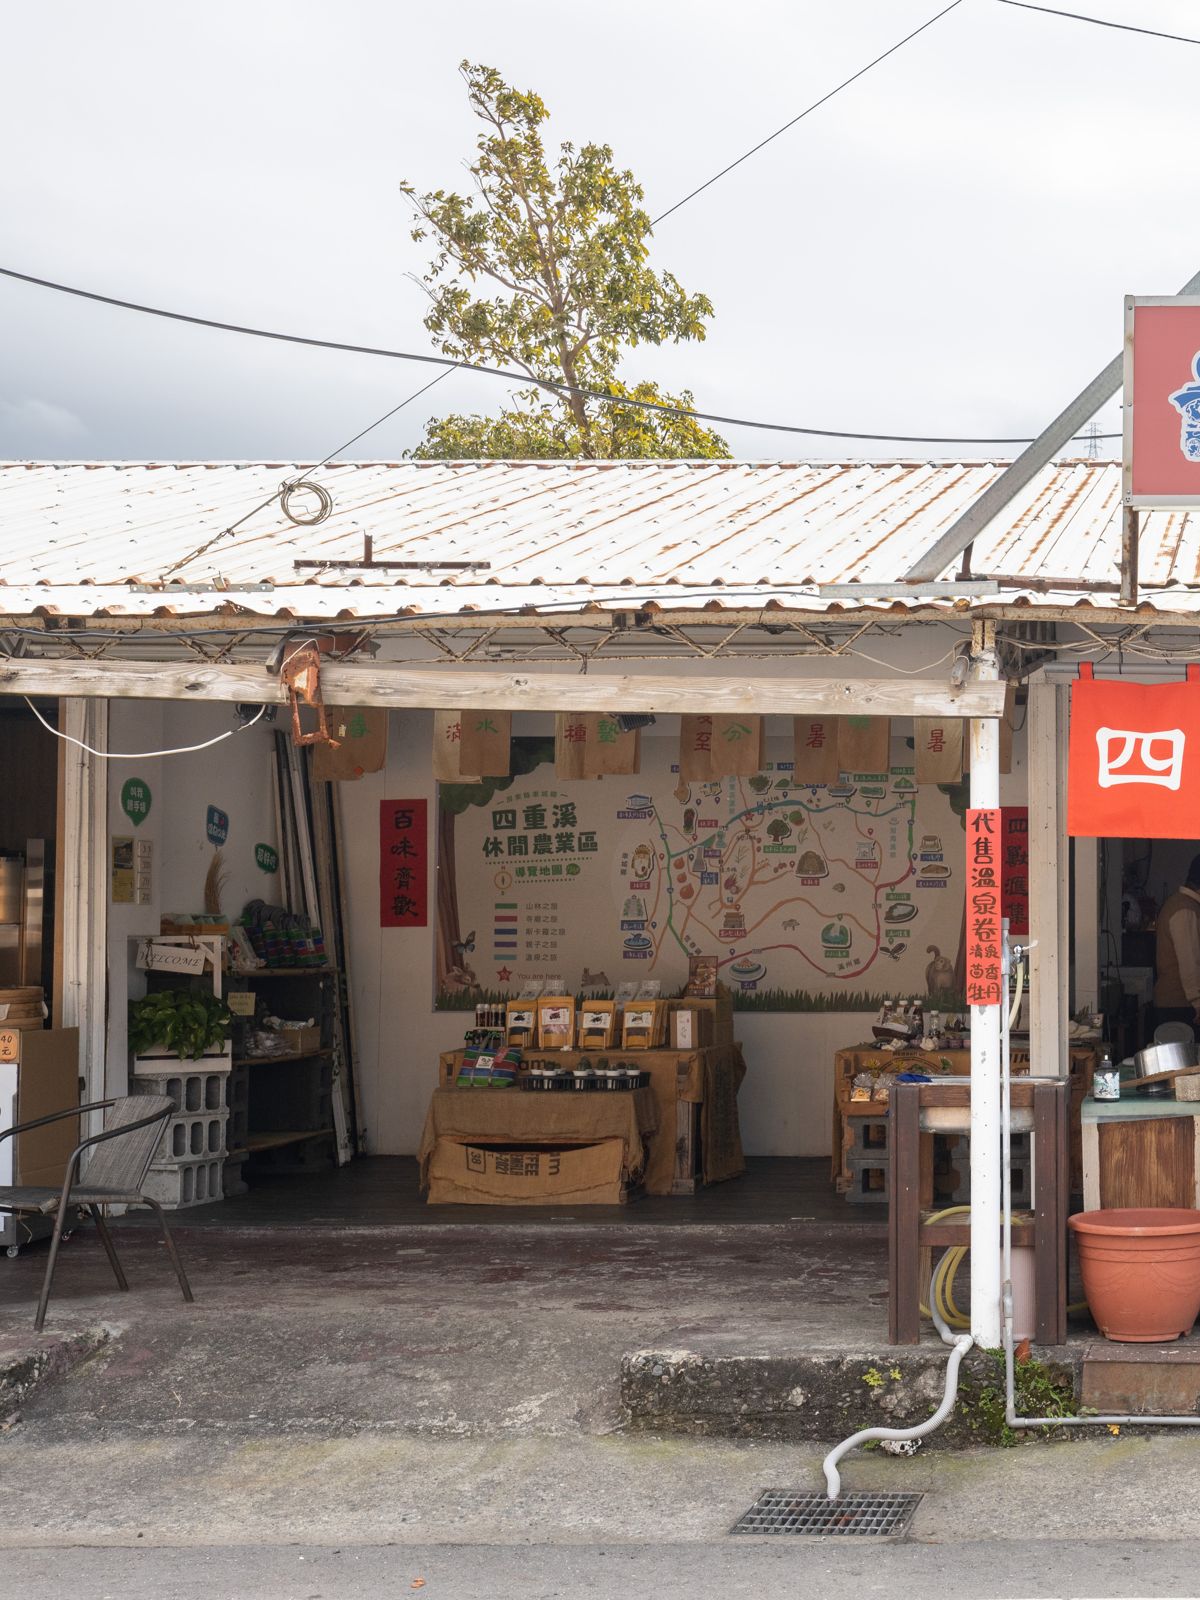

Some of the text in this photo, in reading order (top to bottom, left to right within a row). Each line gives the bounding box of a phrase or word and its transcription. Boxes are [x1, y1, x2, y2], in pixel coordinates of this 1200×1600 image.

[806, 723, 827, 749] 暑
[927, 728, 947, 753] 暑
[491, 802, 578, 831] 四重溪
[482, 831, 599, 858] 休閒農業區
[970, 811, 999, 943] 代售溫泉卷
[969, 944, 1000, 960] 清泉
[967, 982, 1001, 1002] 牡丹
